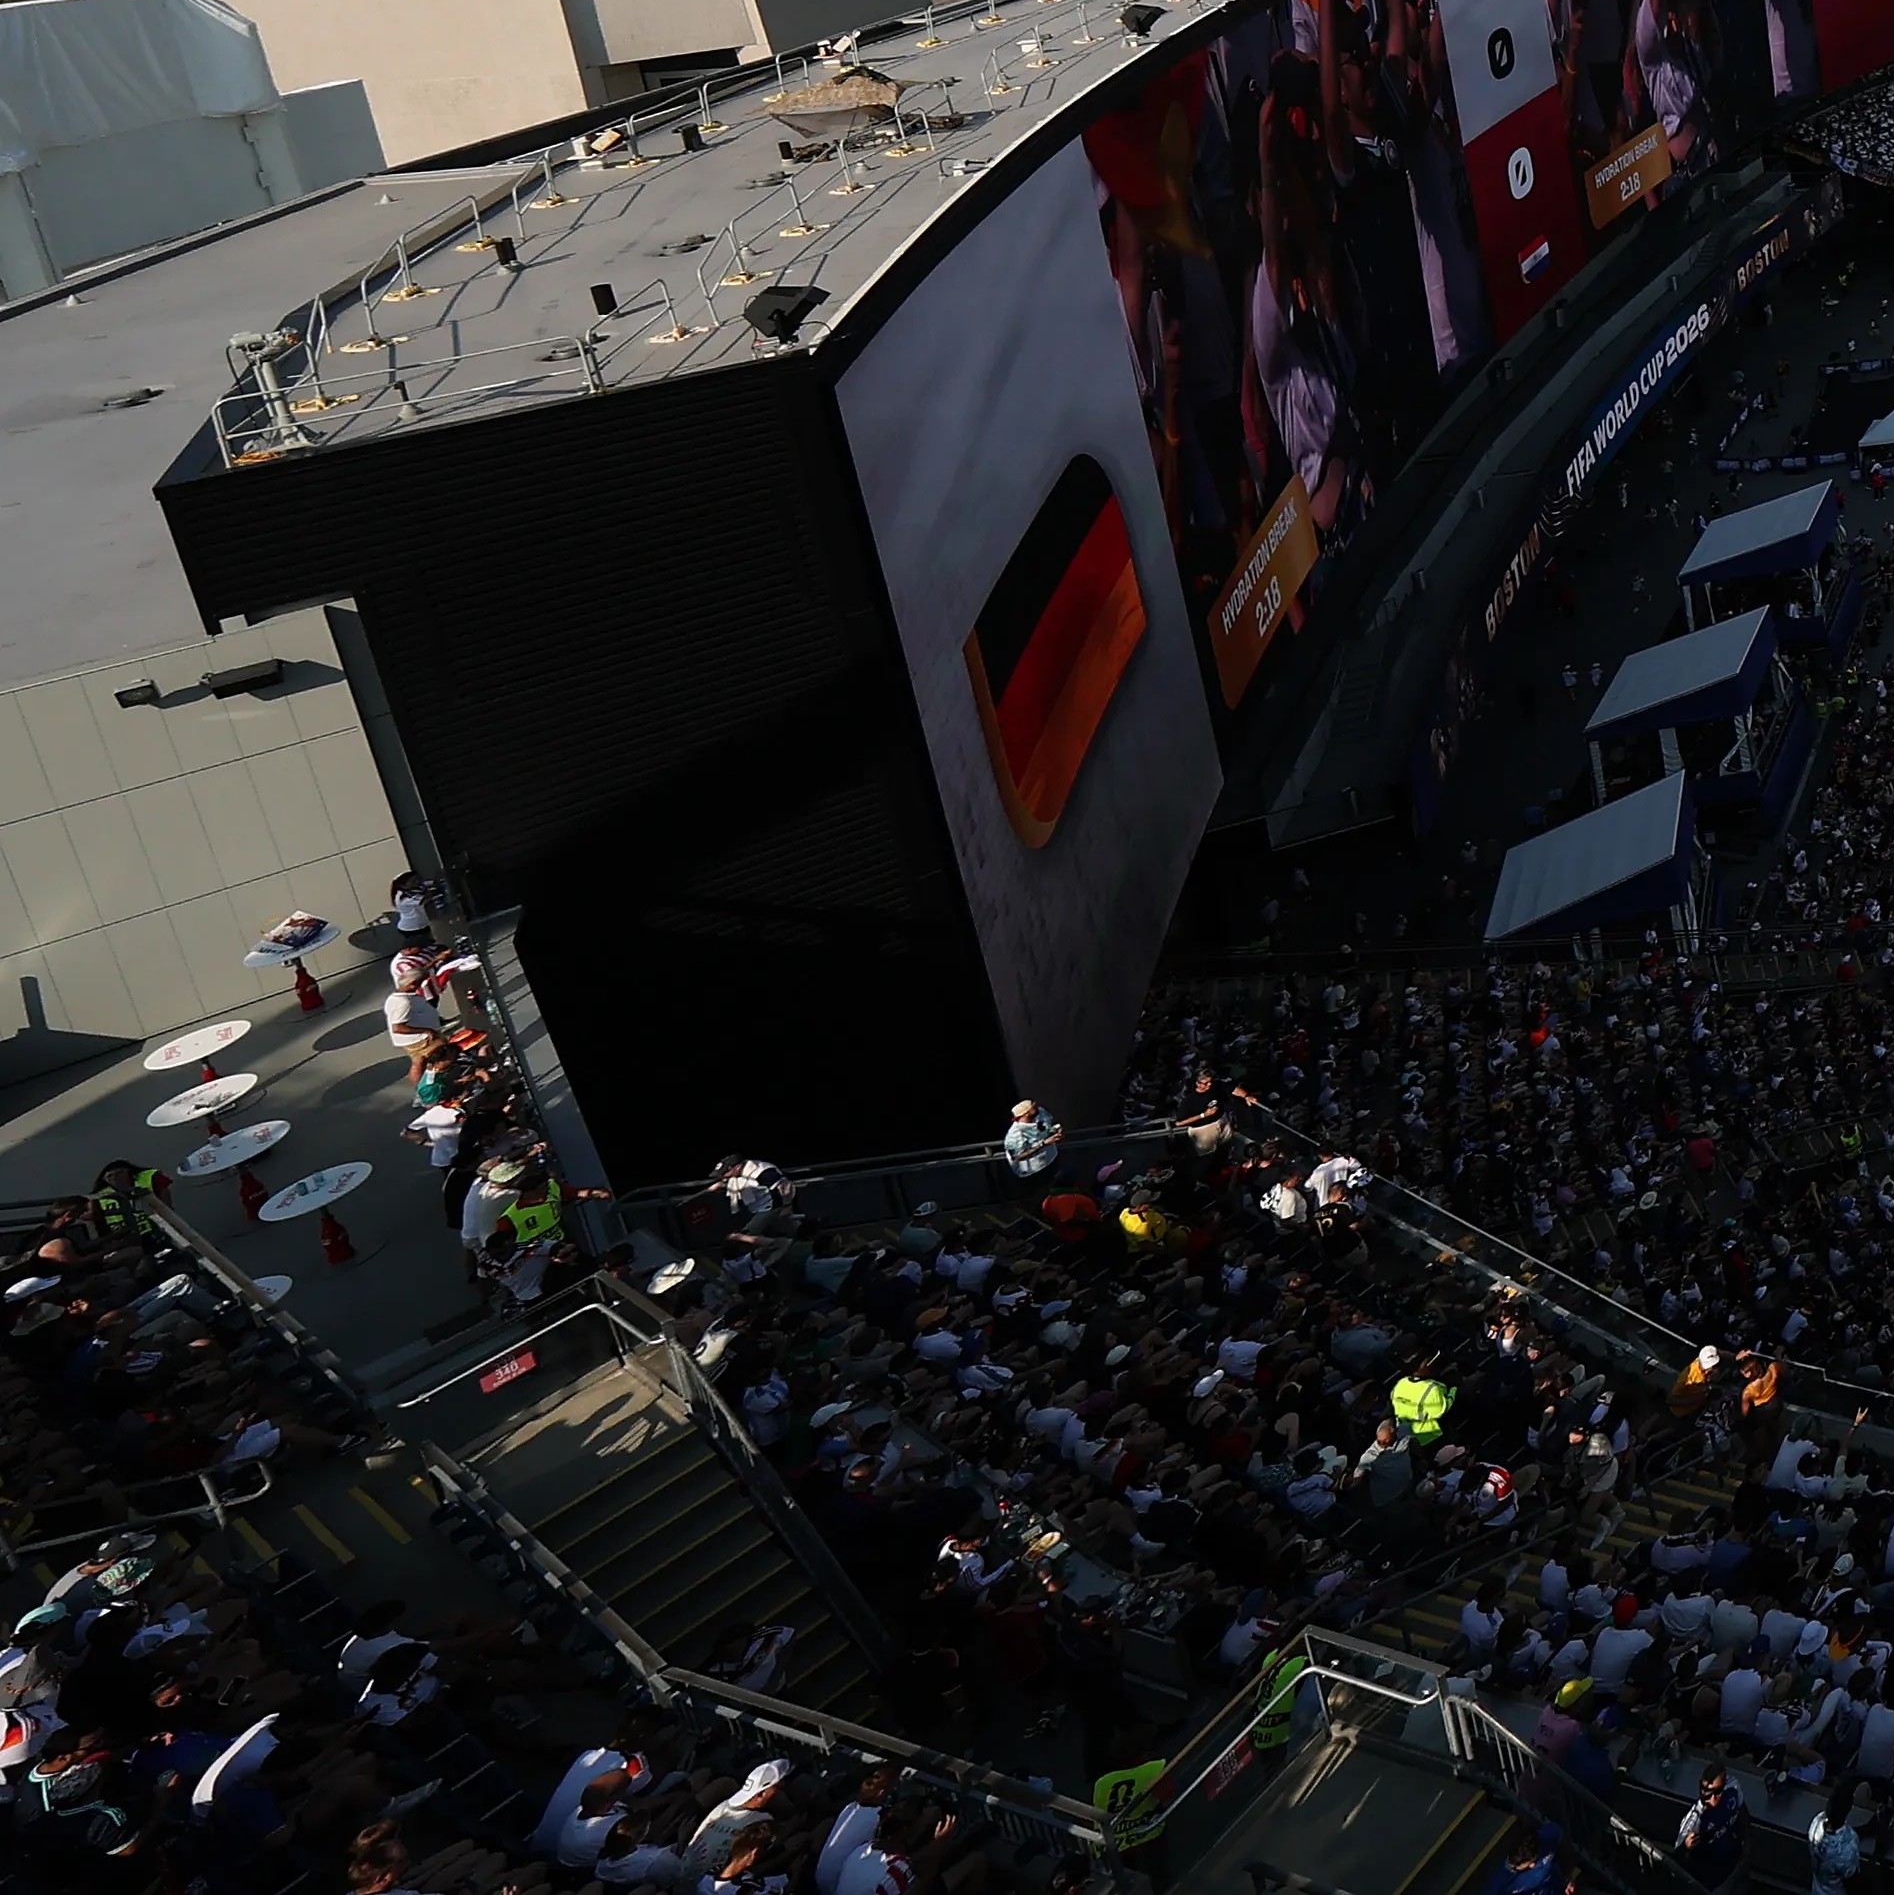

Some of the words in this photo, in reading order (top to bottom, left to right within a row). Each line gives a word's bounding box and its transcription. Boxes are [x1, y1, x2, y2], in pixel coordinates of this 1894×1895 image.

[1487, 27, 1515, 80] 0
[1508, 147, 1535, 200] 0
[1594, 149, 1635, 189] HYDRATION
[1634, 133, 1659, 162] BREAK
[1620, 171, 1641, 201] 2:18
[1736, 228, 1790, 292] BOSTON
[1565, 439, 1597, 499] FIFA
[1593, 383, 1640, 455] WORLD
[1639, 349, 1665, 395] CUP
[1665, 303, 1710, 367] 2026
[1221, 538, 1271, 636] HYDRATION
[1268, 496, 1298, 554] BREAK
[1485, 522, 1542, 643] BOSTON
[1256, 575, 1282, 638] 2:18
[495, 1363, 519, 1380] 340
